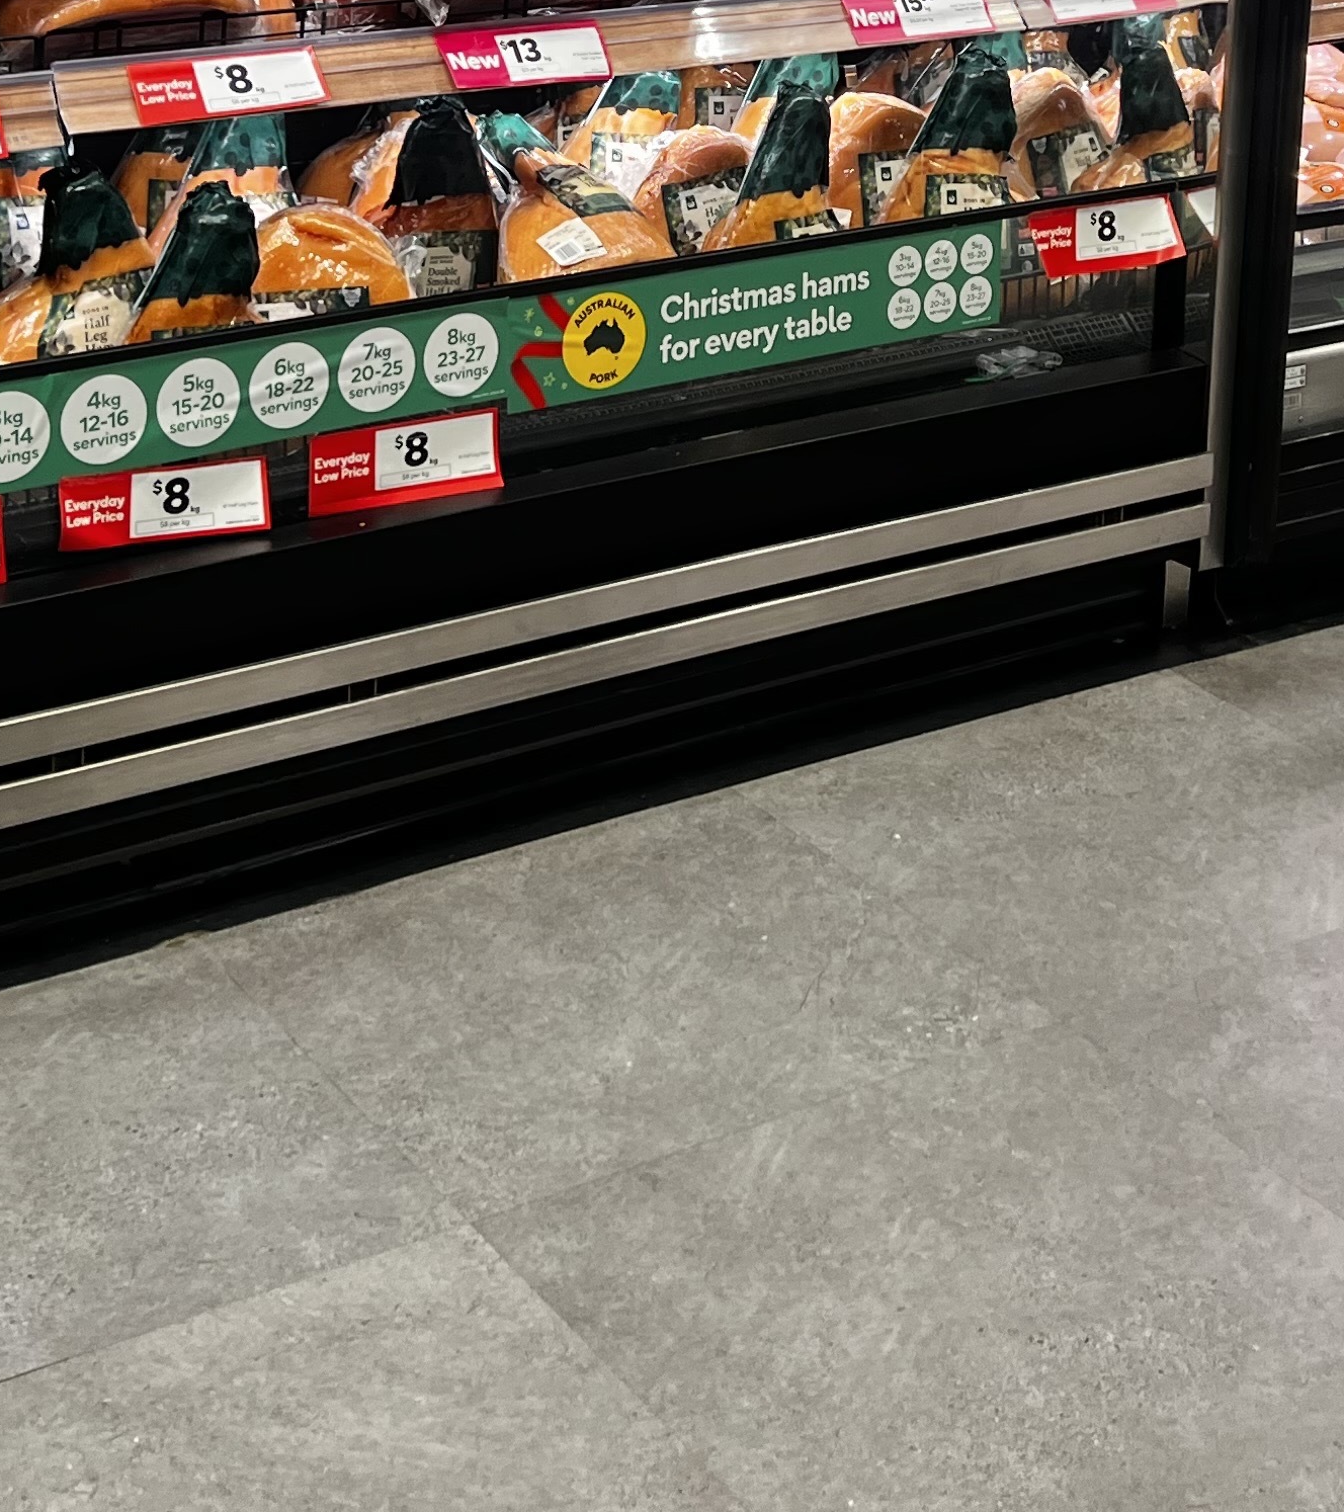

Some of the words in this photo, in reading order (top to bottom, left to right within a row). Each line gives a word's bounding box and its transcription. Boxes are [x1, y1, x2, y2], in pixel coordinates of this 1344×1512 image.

[849, 8, 896, 27] New
[446, 51, 500, 70] New
[500, 39, 542, 64] $13
[137, 78, 193, 93] Everyday
[214, 64, 253, 93] $8
[140, 92, 166, 104] Low
[168, 90, 197, 101] Price
[1032, 225, 1072, 239] Everyday
[1090, 210, 1116, 241] $8
[1050, 238, 1072, 250] Price
[427, 276, 461, 286] Smoked
[660, 282, 796, 324] Christmas
[802, 270, 870, 300] hams
[574, 298, 636, 328] AUSTRALIAN
[85, 332, 108, 343] Leg
[447, 328, 476, 346] 8kg
[659, 333, 701, 363] for
[704, 323, 779, 355] every
[784, 305, 852, 340] table
[362, 343, 391, 361] 7kg
[438, 345, 485, 368] 23-27
[275, 358, 305, 376] 6kg
[351, 360, 403, 383] 20-25
[434, 365, 489, 384] servings
[589, 369, 618, 384] PORK
[183, 374, 213, 392] 5kg
[265, 376, 314, 399] 18-22
[349, 380, 405, 400] servings
[86, 392, 121, 409] 4kg
[172, 392, 225, 416] 15-20
[260, 396, 319, 416] servings
[79, 410, 129, 433] 12-16
[170, 413, 230, 433] servings
[73, 430, 137, 451] servings
[395, 431, 429, 467] $8
[314, 451, 371, 471] Everyday
[315, 472, 339, 484] Low
[341, 467, 370, 480] Price
[64, 495, 125, 513] Everyday
[152, 476, 190, 514] $8
[66, 516, 90, 528] Low
[93, 511, 124, 524] Price
